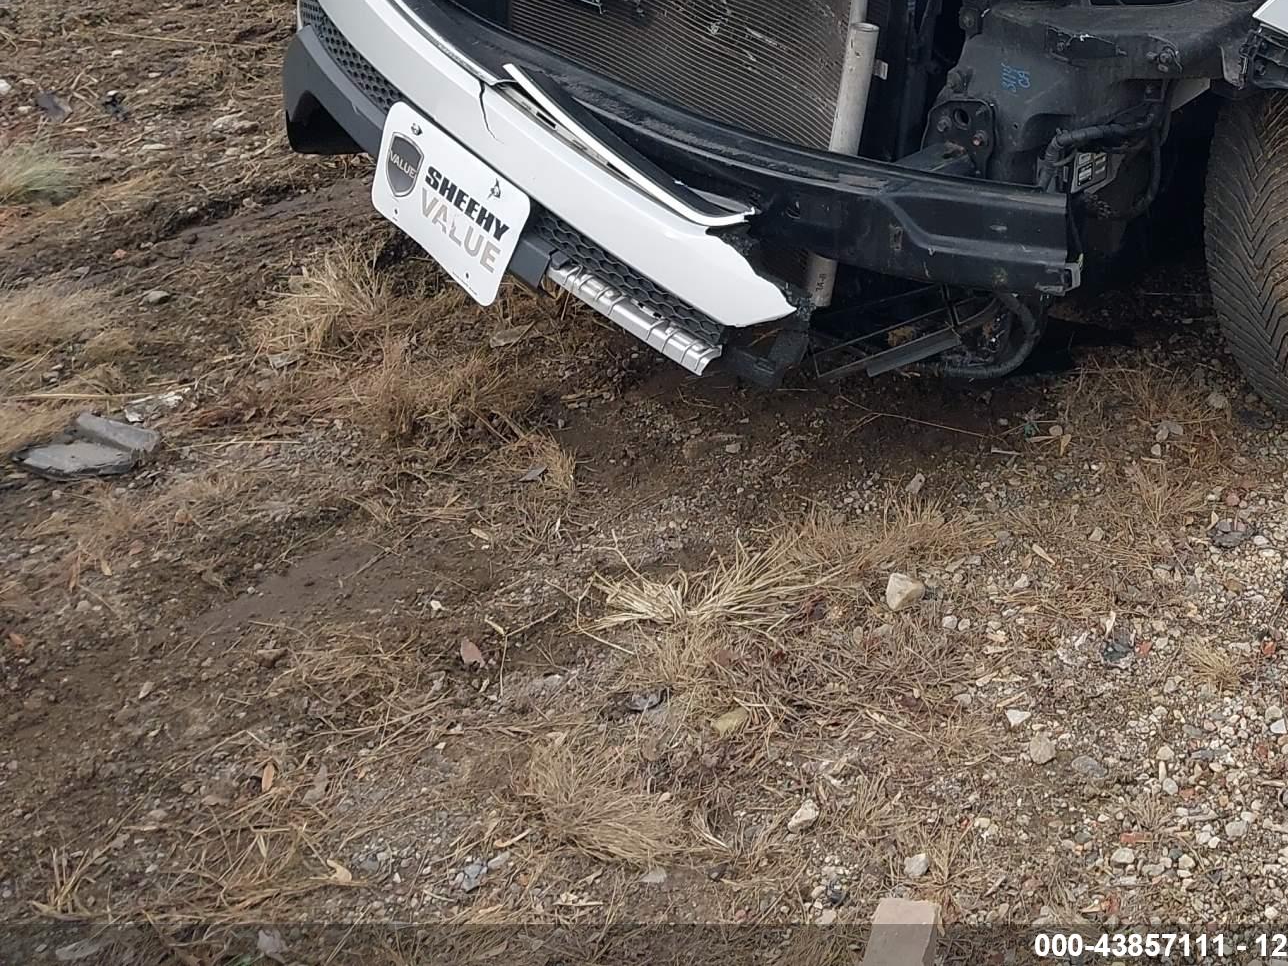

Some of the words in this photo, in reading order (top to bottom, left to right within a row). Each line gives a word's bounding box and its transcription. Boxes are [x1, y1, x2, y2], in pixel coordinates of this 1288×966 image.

[389, 150, 418, 179] VALUE
[421, 187, 501, 274] VALUE
[424, 165, 510, 242] SHEEHY
